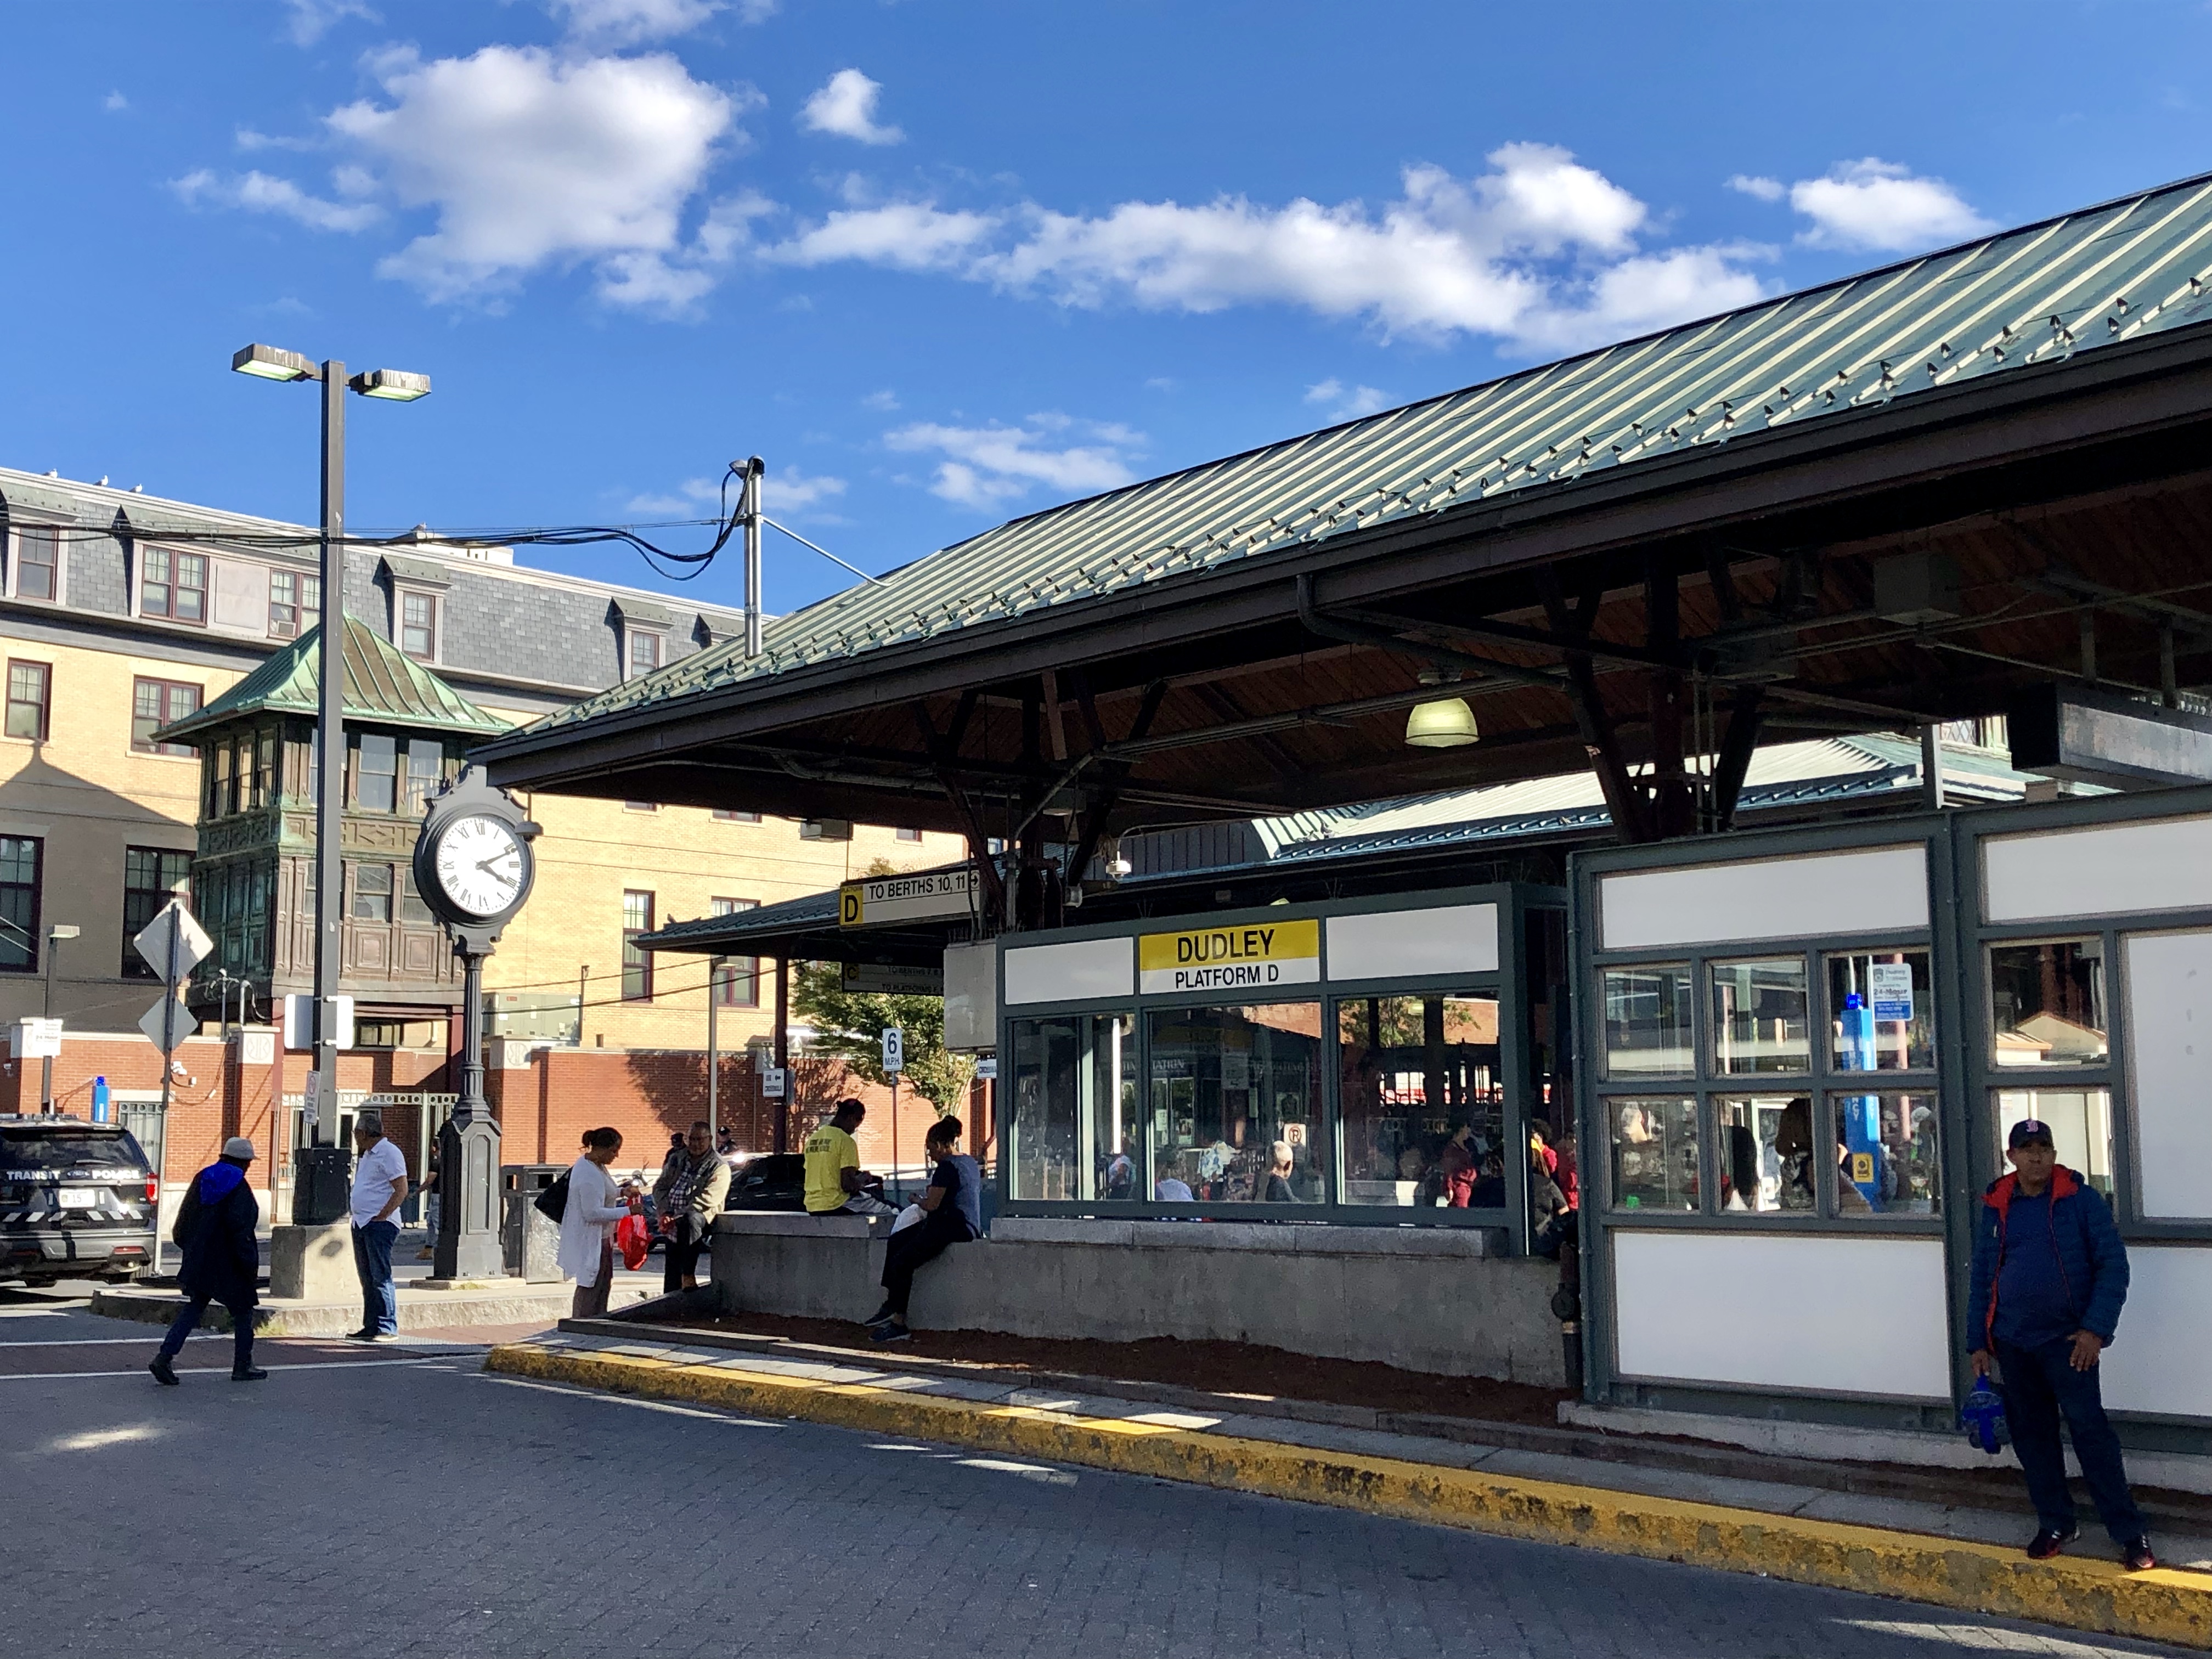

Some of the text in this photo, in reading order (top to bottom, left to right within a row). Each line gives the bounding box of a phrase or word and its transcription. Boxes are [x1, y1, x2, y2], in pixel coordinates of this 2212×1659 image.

[869, 874, 965, 899] TO BERTHS 10, 11
[845, 895, 859, 922] D
[1178, 929, 1275, 963] DUDLEY
[847, 967, 857, 980] C
[1176, 964, 1279, 989] PLATFORM D
[888, 1032, 898, 1054] 6
[6, 1170, 61, 1180] TRANSIT
[92, 1170, 140, 1180] POLICE
[72, 1194, 82, 1203] 15
